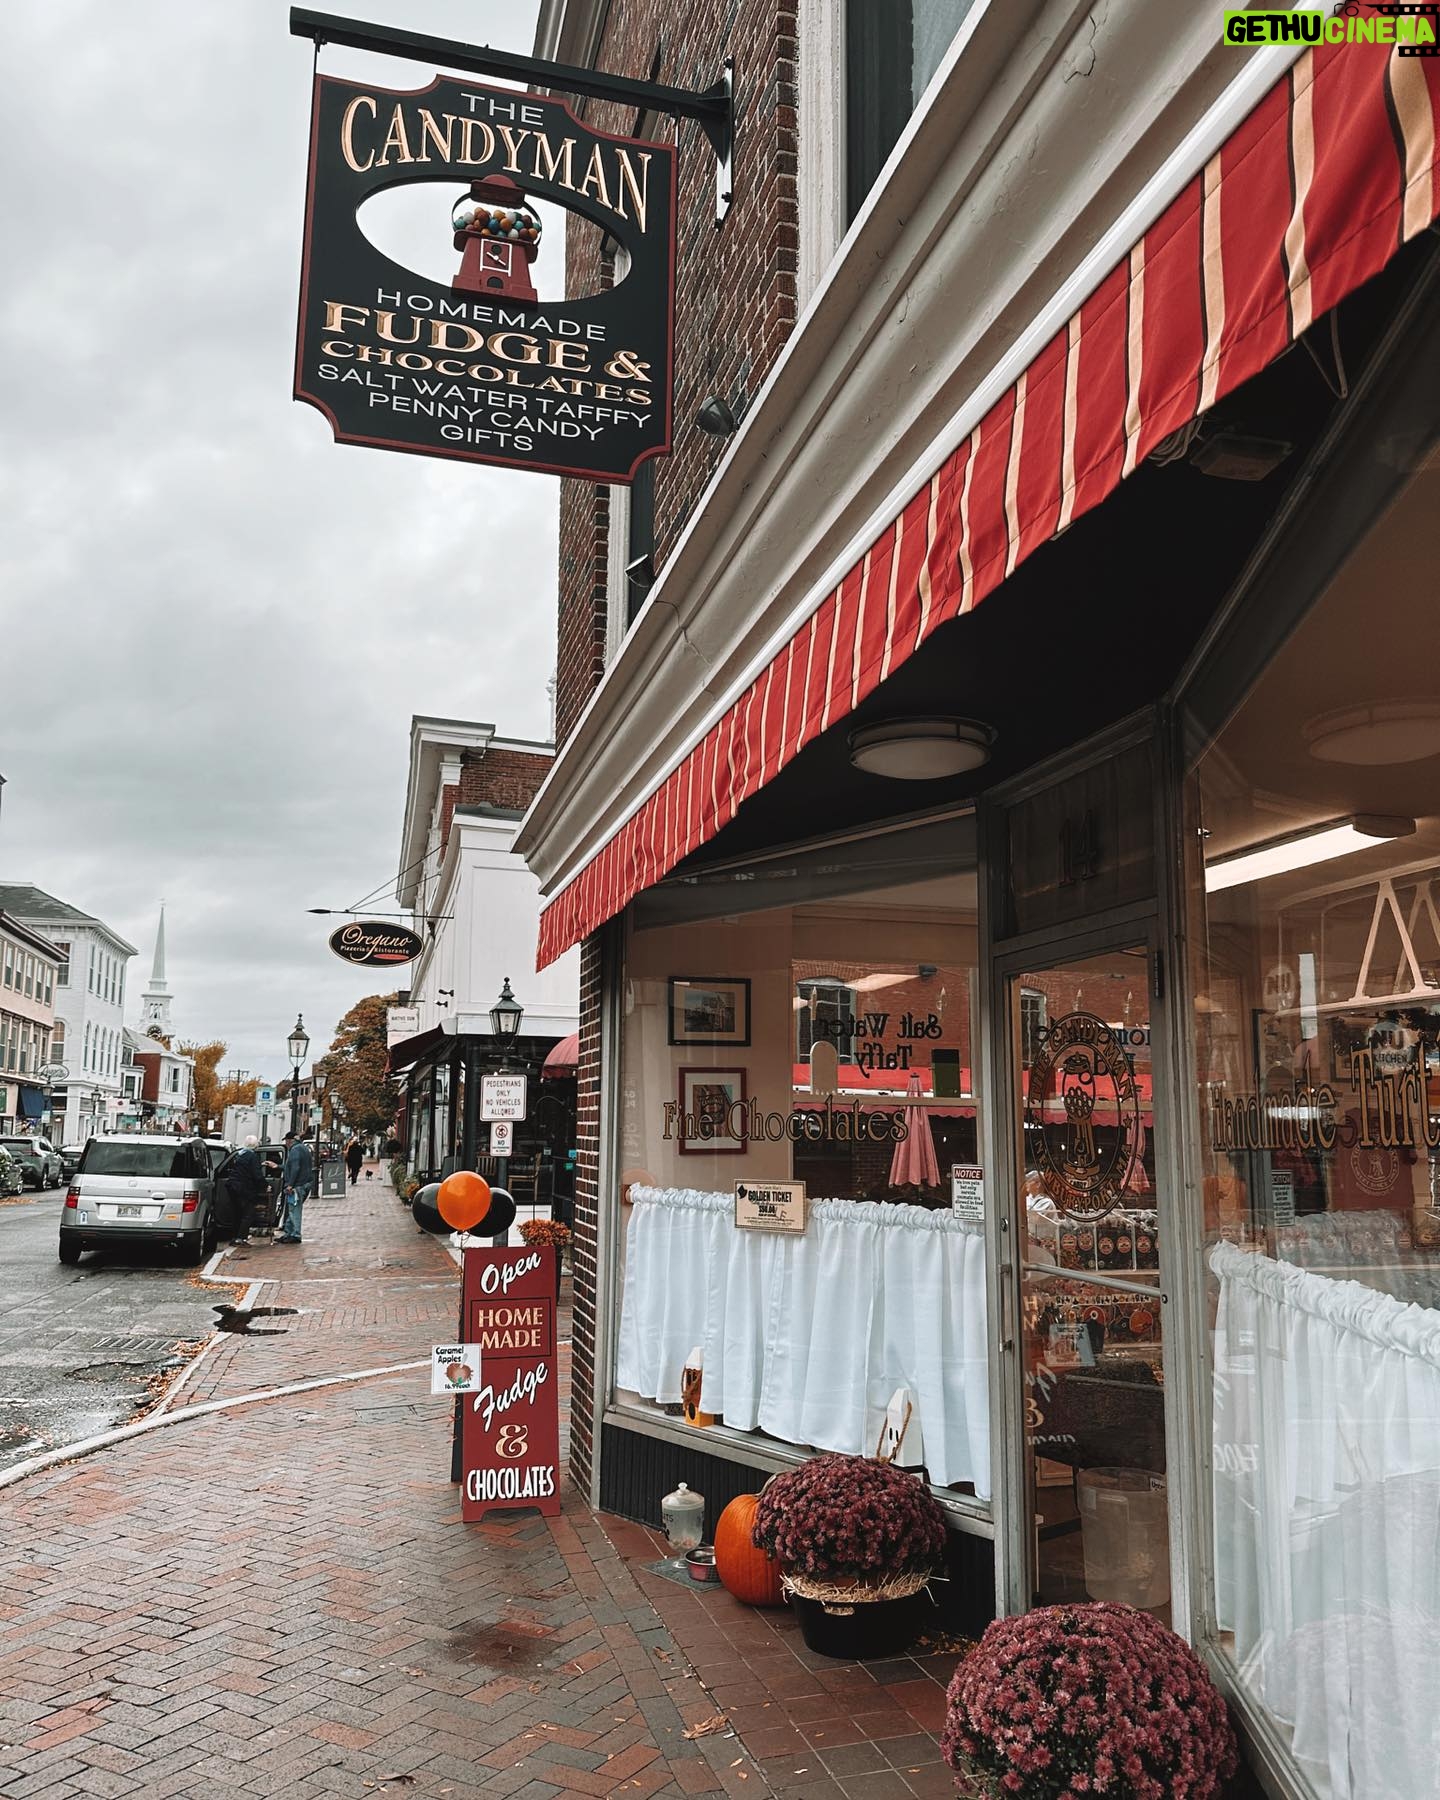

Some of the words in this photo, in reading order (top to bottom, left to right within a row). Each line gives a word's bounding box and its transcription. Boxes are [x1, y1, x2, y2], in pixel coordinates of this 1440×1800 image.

[461, 93, 544, 126] THE
[341, 95, 652, 233] CANDYMAN
[377, 288, 606, 341] HOMEMADE
[321, 300, 592, 373] FUDGE
[603, 350, 653, 383] &
[317, 363, 404, 391] SALT
[412, 378, 527, 411] WATER
[320, 340, 653, 406] CHOCOLATES
[369, 391, 483, 422] PENNY
[490, 411, 604, 441] CANDY
[440, 423, 534, 452] GIFTS
[341, 925, 413, 961] Oregano
[486, 1080, 522, 1088] PEDESTRIANS
[1212, 1049, 1337, 1152] Handmade
[663, 1101, 714, 1140] Fine
[723, 1094, 909, 1143] Chocolates
[955, 1170, 982, 1178] NOTICE
[748, 1190, 771, 1202] GOLDEN
[772, 1191, 792, 1202] TICKET
[480, 1251, 542, 1295] Open
[478, 1307, 543, 1328] HOME
[435, 1346, 464, 1355] Caramel
[480, 1329, 541, 1349] MADE
[438, 1355, 461, 1364] Apples
[473, 1361, 548, 1432] Fudge
[495, 1424, 528, 1459] &
[466, 1465, 555, 1501] CHOCOLATES
